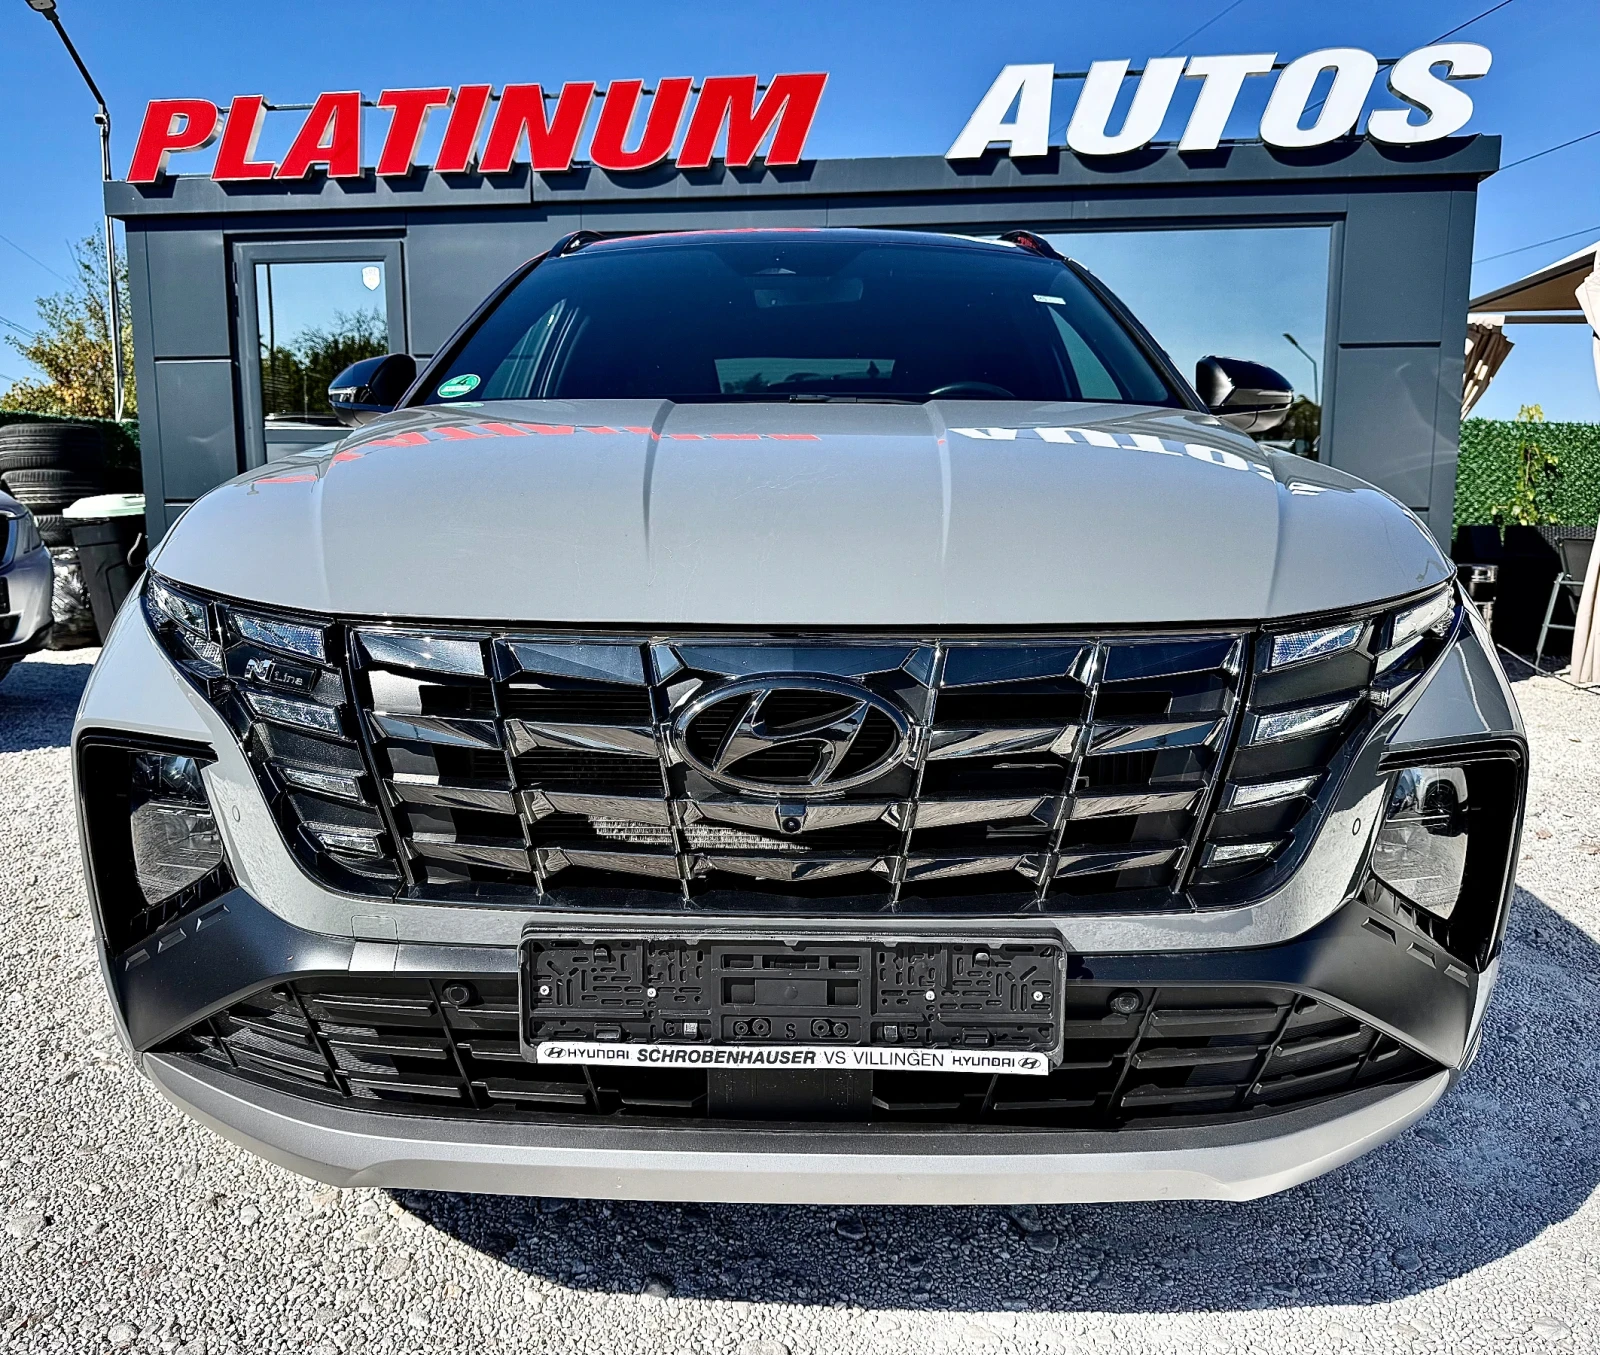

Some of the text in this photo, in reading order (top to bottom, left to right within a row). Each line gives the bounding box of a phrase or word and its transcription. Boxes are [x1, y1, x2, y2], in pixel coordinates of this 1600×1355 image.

[126, 42, 1493, 184] PLATINUM AUTOS
[274, 671, 303, 686] Line
[567, 1048, 1015, 1068] HYUNDAI SCHROBENHAUSER VS VILLINGEN HYUNDAI
